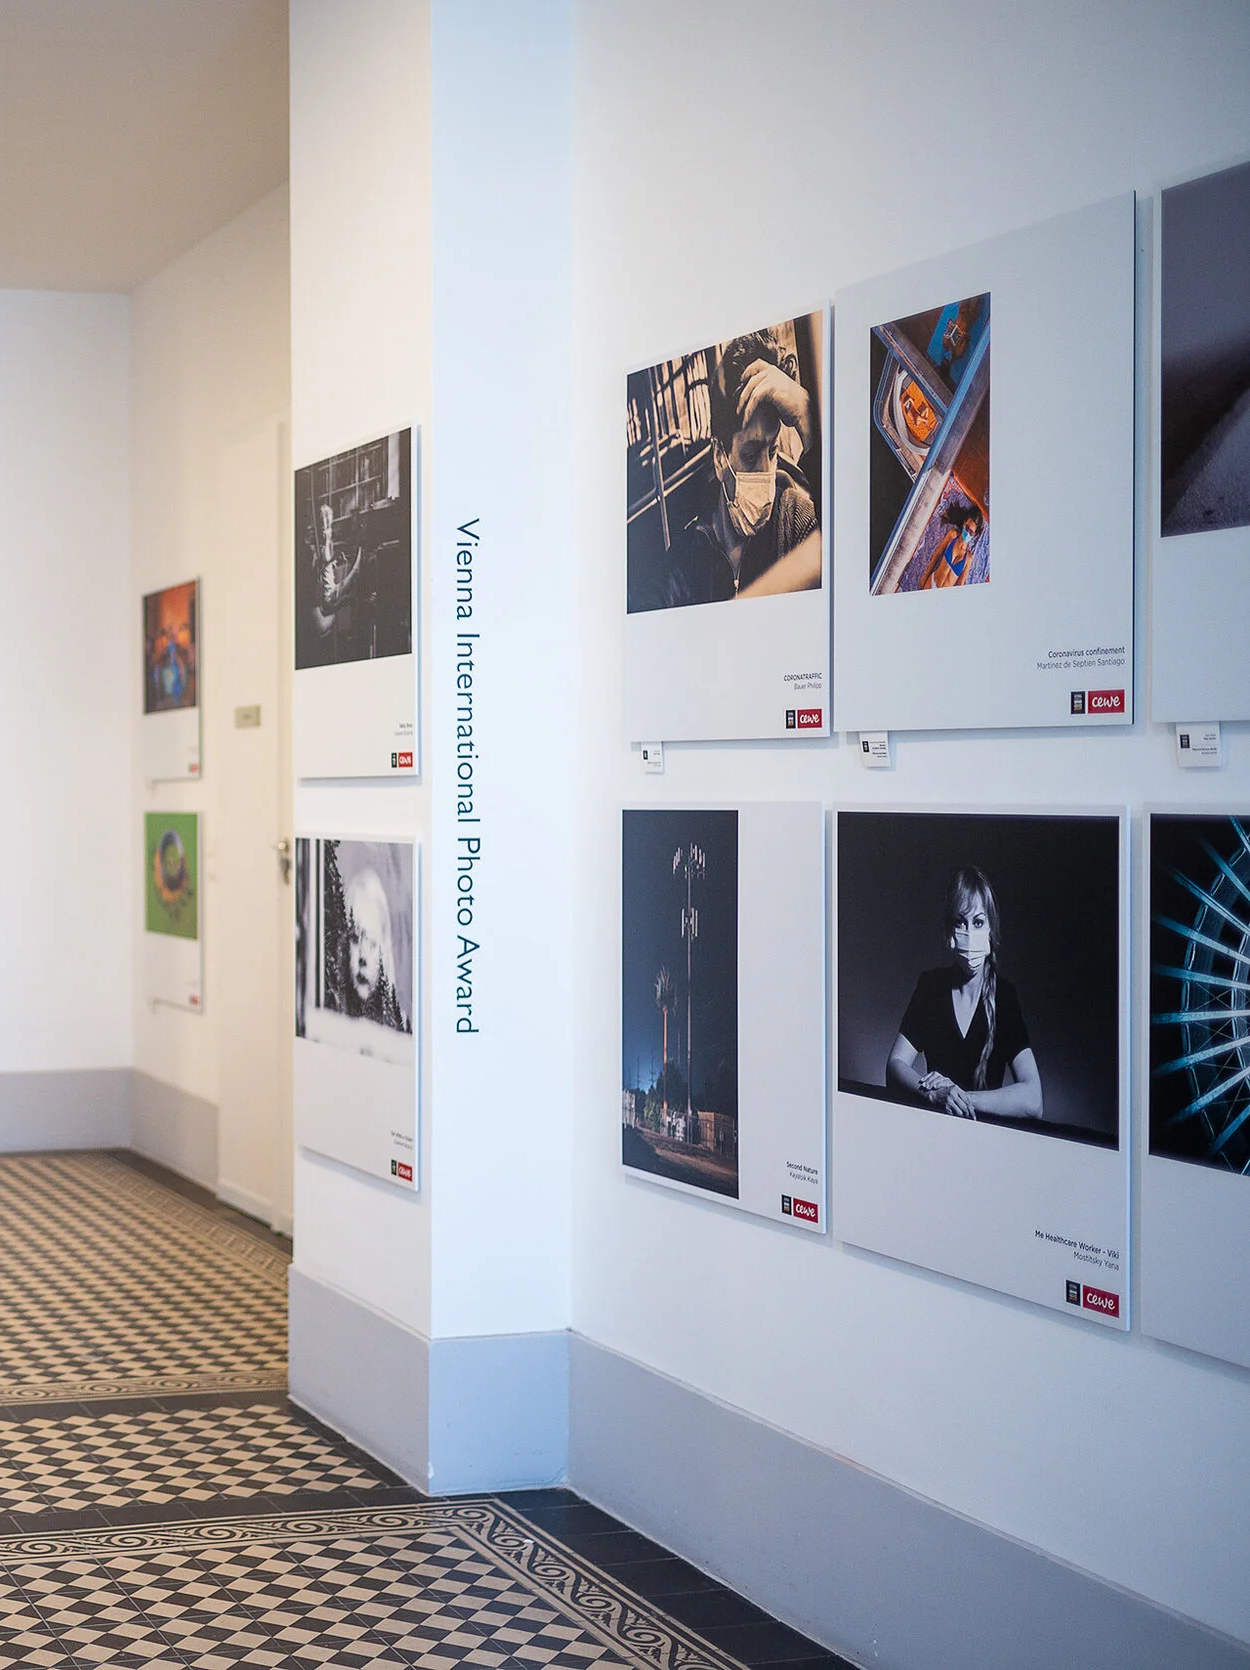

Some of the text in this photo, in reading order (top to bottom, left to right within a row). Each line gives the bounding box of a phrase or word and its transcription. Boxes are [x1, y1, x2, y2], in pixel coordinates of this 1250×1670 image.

[1048, 646, 1125, 658] Coronavirus confinement
[1063, 660, 1071, 669] de
[1091, 695, 1121, 708] cewe
[799, 713, 820, 724] cewe
[456, 518, 481, 1033] Vienna International Photo Award
[786, 1160, 803, 1172] Second
[795, 1203, 816, 1218] cewe
[1034, 1229, 1045, 1239] Me
[1045, 1232, 1078, 1249] Healthcare
[1078, 1241, 1102, 1255] Worker
[1086, 1292, 1116, 1310] cewe
